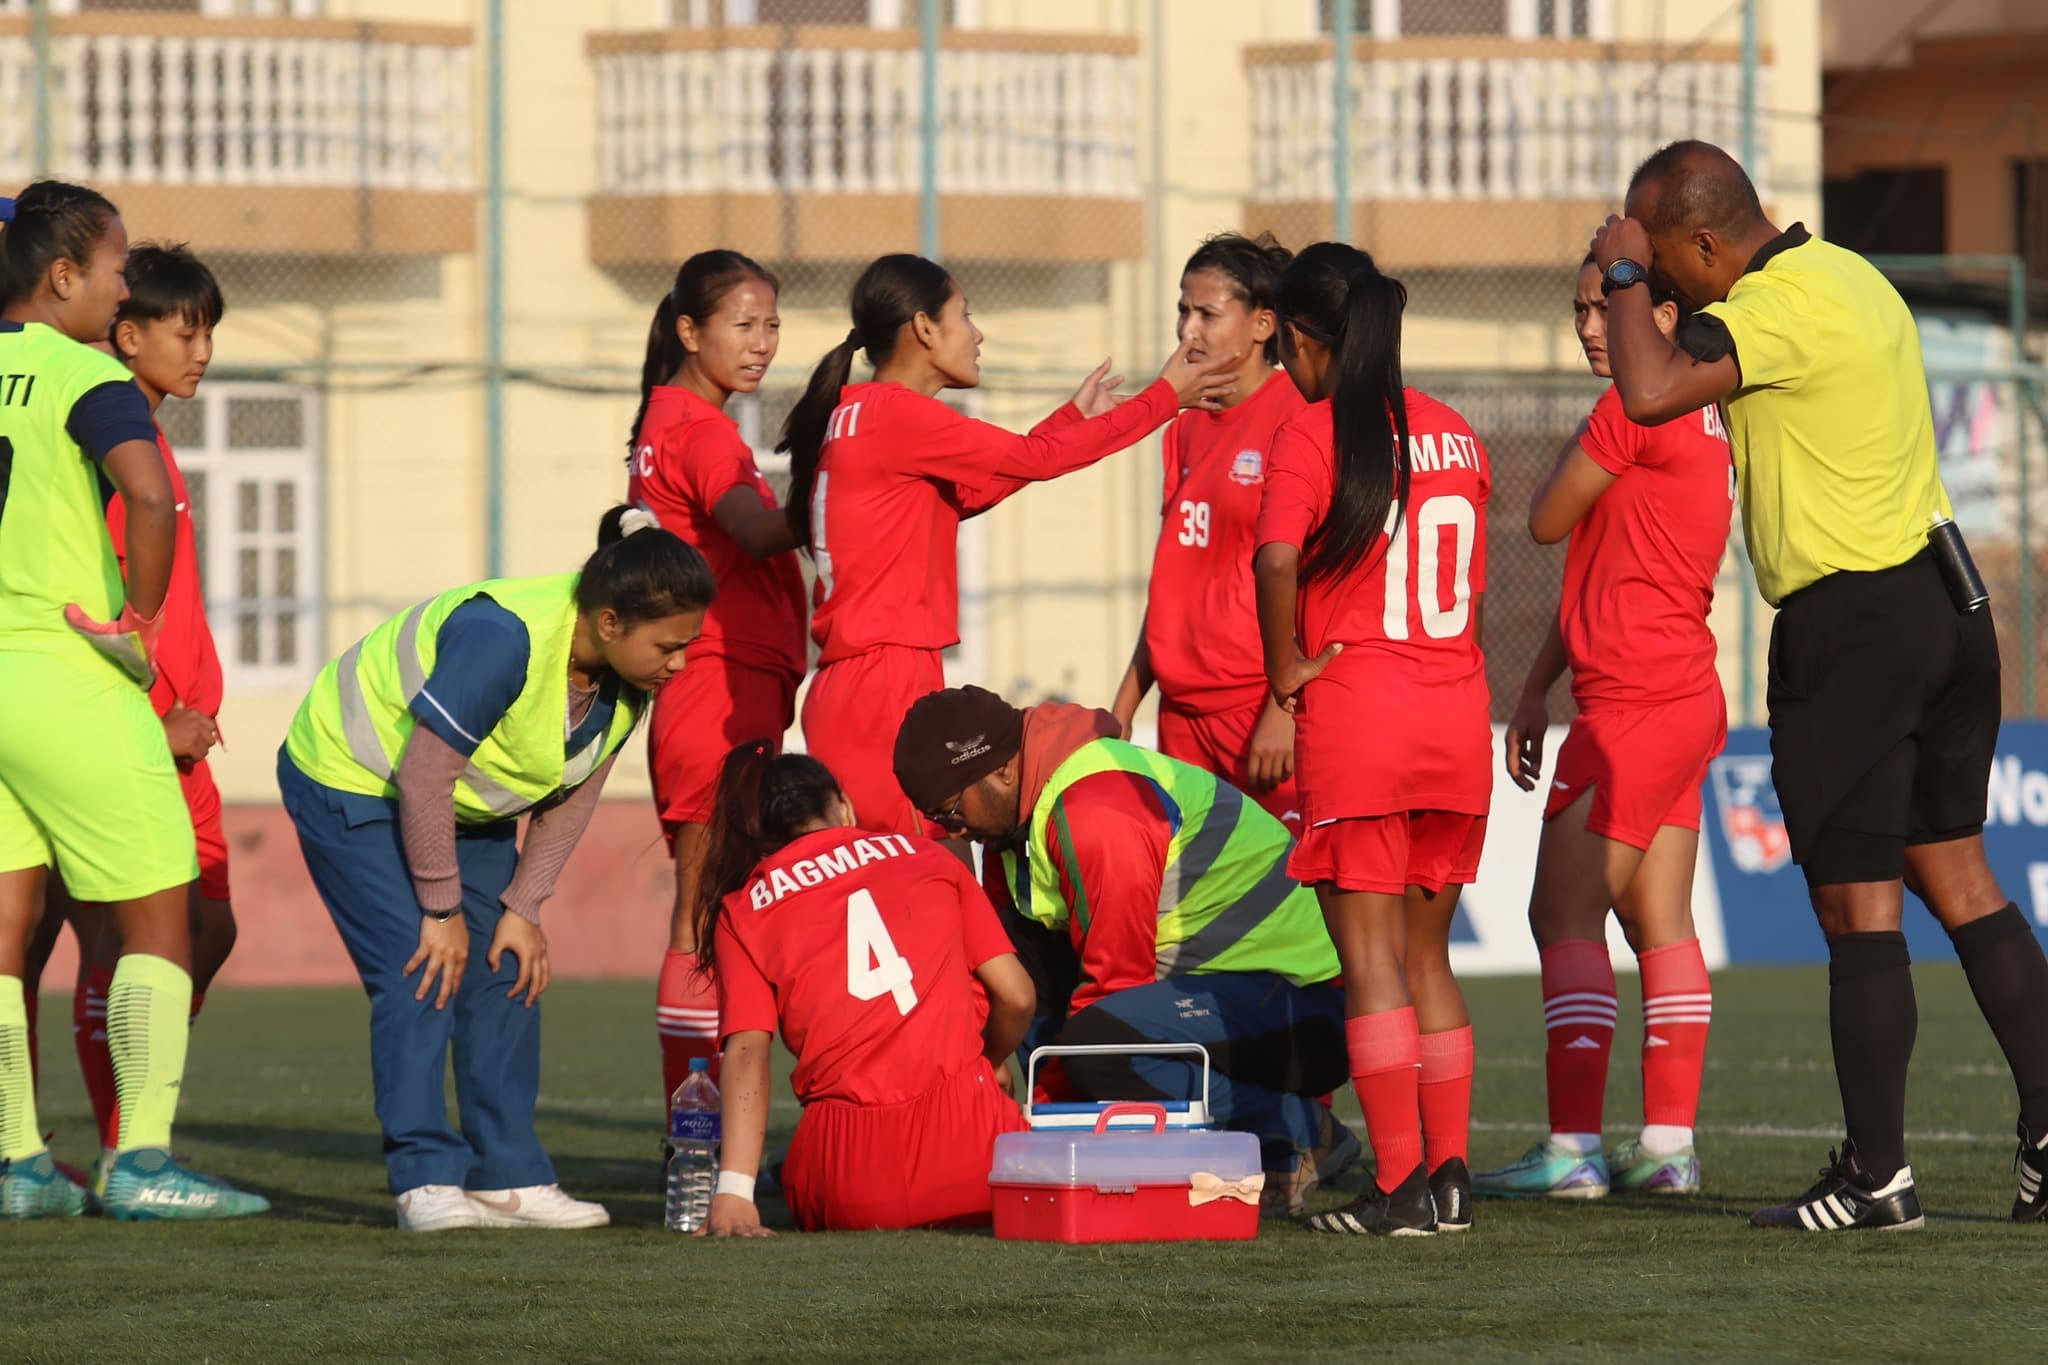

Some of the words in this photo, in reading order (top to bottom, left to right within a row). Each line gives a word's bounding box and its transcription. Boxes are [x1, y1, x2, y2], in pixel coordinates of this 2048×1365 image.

[0, 373, 36, 407] TI
[1178, 500, 1210, 547] 39
[1382, 495, 1476, 640] 10
[951, 744, 991, 765] adidas
[750, 834, 917, 911] BAGMATI
[847, 887, 919, 1017] 4
[681, 1120, 713, 1129] AQUA
[140, 1186, 219, 1207] KELME
